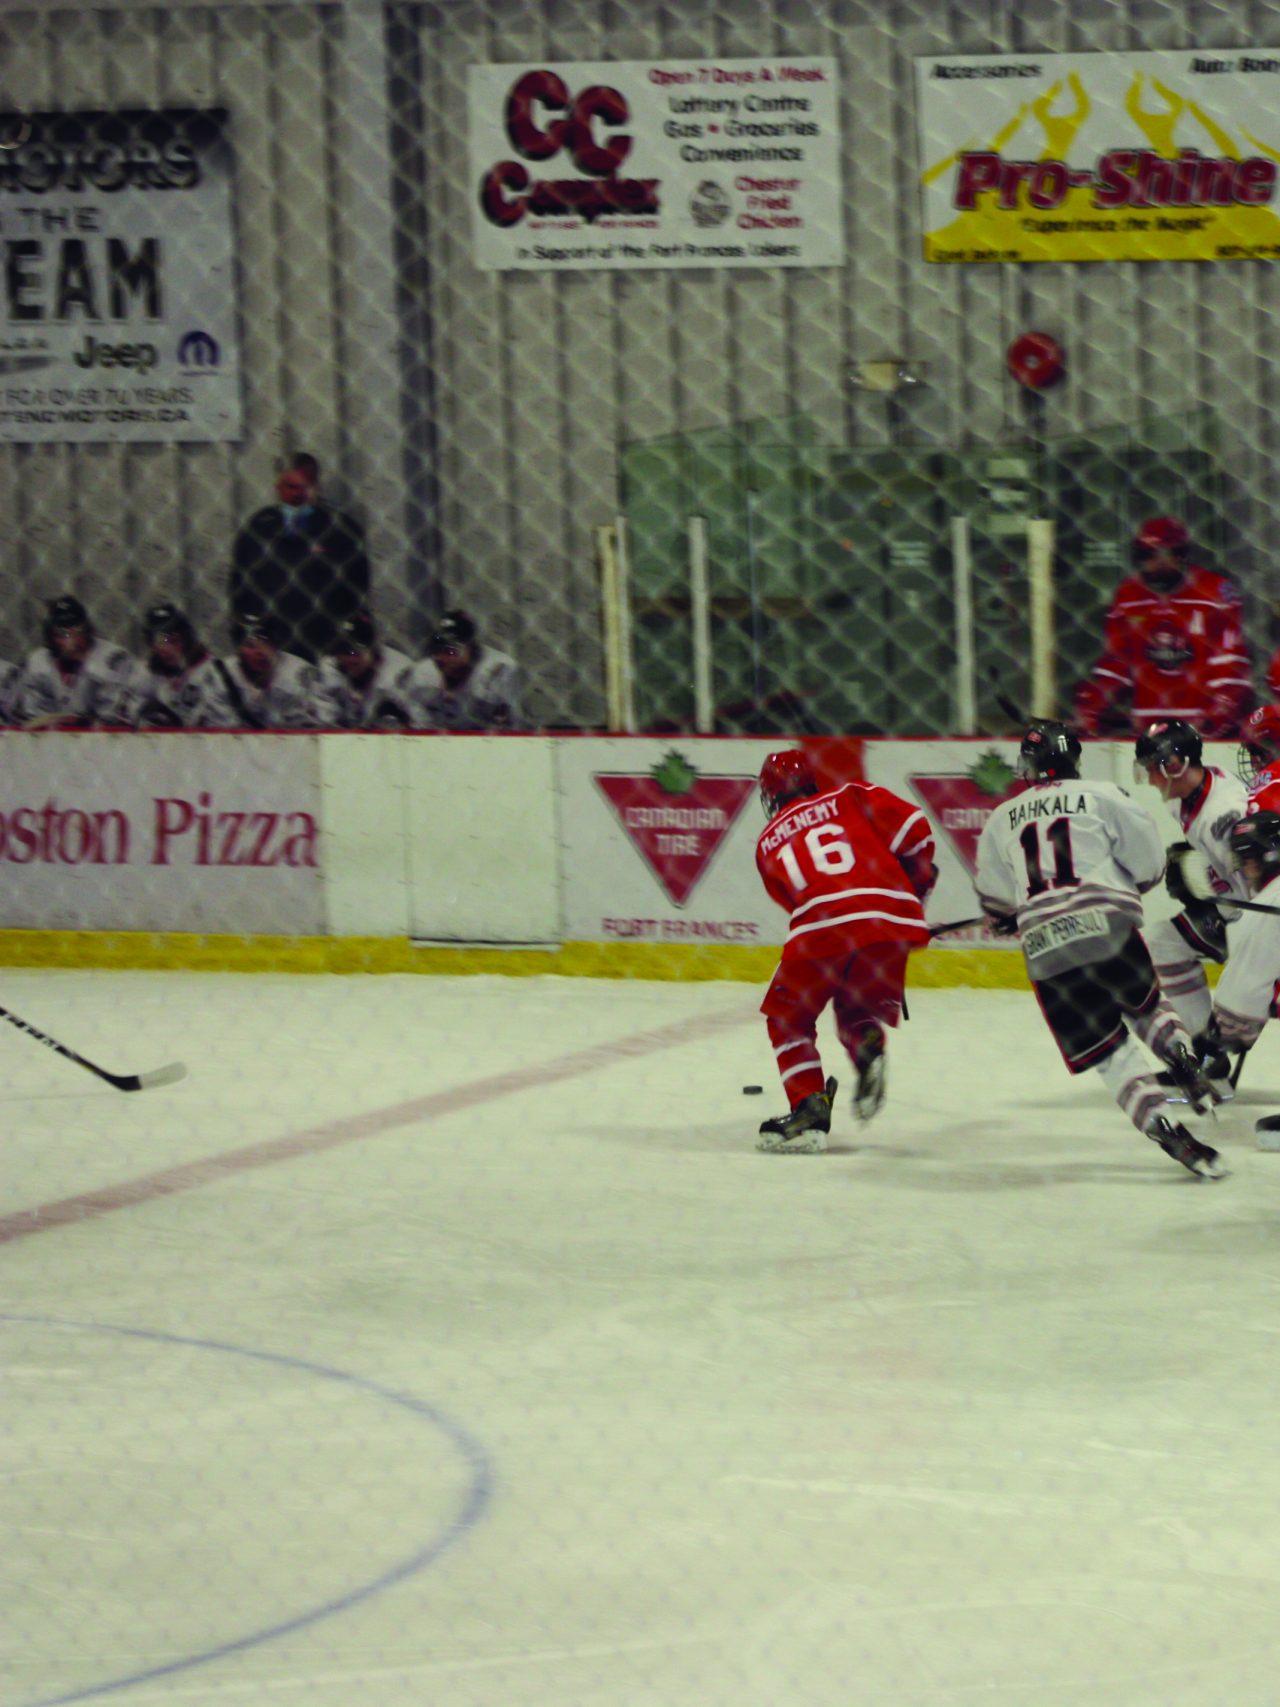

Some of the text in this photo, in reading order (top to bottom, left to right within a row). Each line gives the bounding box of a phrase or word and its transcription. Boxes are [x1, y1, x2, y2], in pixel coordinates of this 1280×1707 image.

[954, 149, 1278, 210] Pro-Shine
[17, 207, 100, 232] THE
[5, 239, 162, 321] EAM
[74, 336, 160, 375] Jeep
[0, 791, 320, 868] ston Pizza
[761, 798, 841, 856] McMENEMY
[1009, 795, 1087, 831] HAHKALA
[656, 833, 700, 856] TIRE
[776, 823, 857, 892] 16
[1019, 816, 1082, 899] 11
